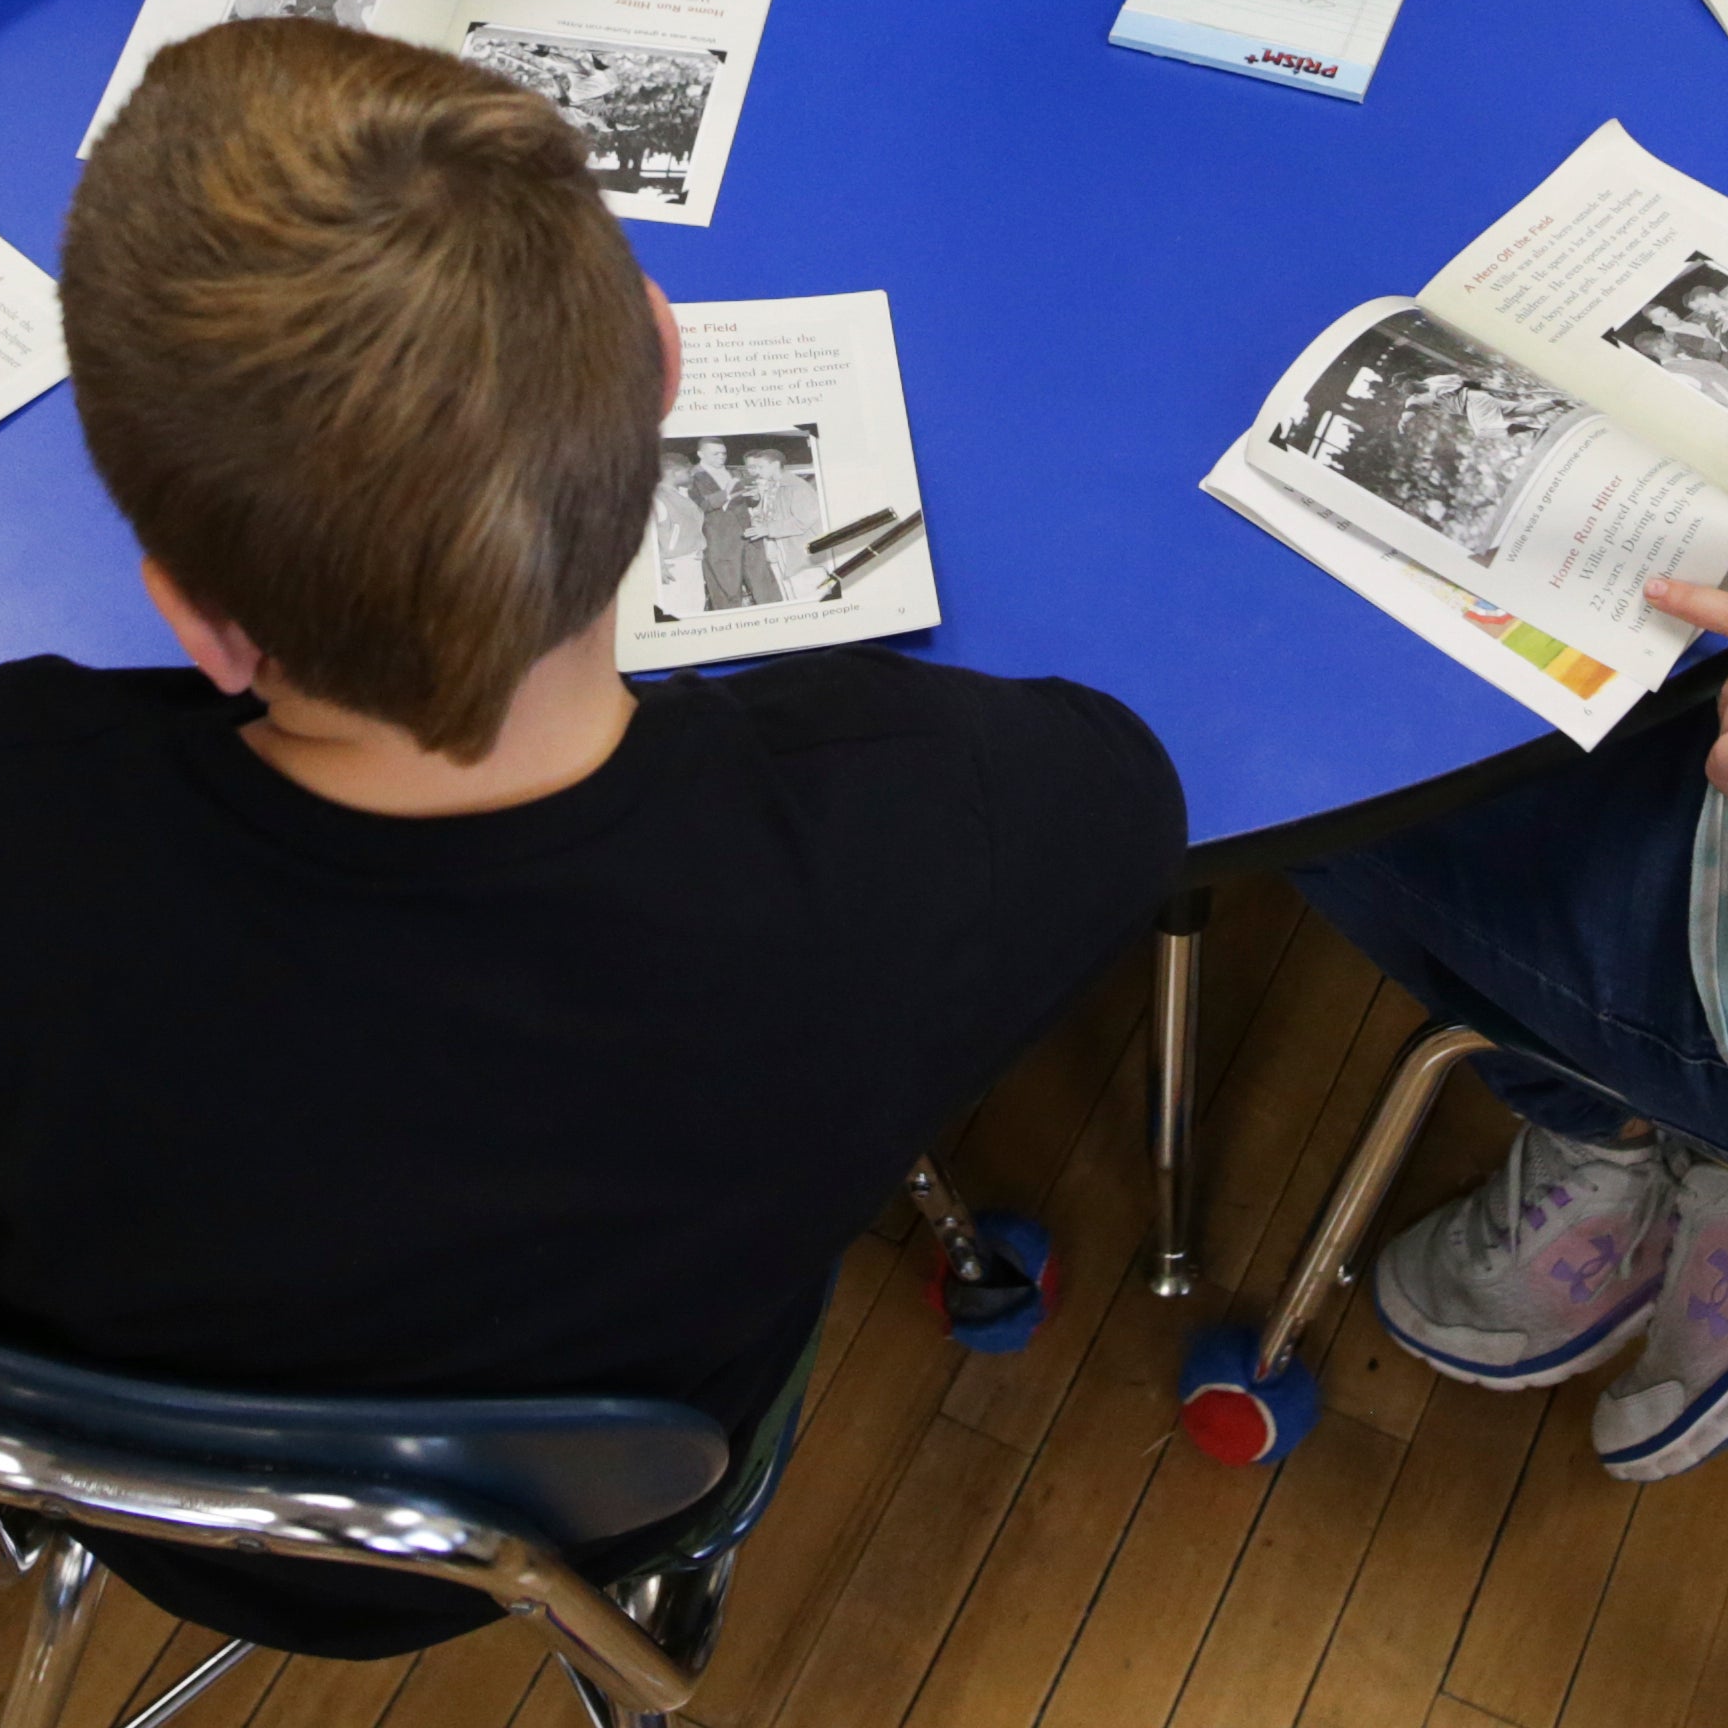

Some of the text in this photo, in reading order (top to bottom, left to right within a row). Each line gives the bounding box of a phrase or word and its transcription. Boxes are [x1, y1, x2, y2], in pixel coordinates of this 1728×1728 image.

[614, 0, 724, 17] Home Run Hitter
[1464, 215, 1554, 294] A Hero Off the Field
[679, 323, 737, 335] he Field
[681, 339, 700, 350] lso
[716, 339, 744, 348] hero
[748, 335, 792, 346] outside
[797, 333, 816, 343] the
[681, 356, 707, 368] pent
[724, 353, 741, 362] lot
[745, 352, 758, 361] of
[762, 352, 789, 360] time
[794, 348, 840, 359] helping
[711, 367, 756, 381] opened
[772, 367, 808, 377] sports
[813, 362, 851, 372] center
[715, 383, 756, 396] Maybe
[788, 379, 801, 389] of
[805, 378, 837, 388] them
[689, 401, 708, 411] the
[713, 402, 739, 410] next
[743, 397, 782, 408] Willie
[1506, 534, 1528, 562] Willie
[1523, 513, 1540, 533] was
[1542, 477, 1562, 504] great
[1549, 475, 1622, 589] Home Run Hitter
[1579, 546, 1607, 579] Willie
[1598, 503, 1630, 546] played
[1589, 594, 1605, 612] 22
[1620, 510, 1655, 555] During
[1650, 487, 1670, 507] that
[1611, 598, 1630, 622] 660
[1623, 563, 1650, 597] home
[1664, 498, 1690, 524] Only
[1657, 547, 1685, 580] home
[633, 630, 666, 640] Willie
[670, 627, 708, 637] always
[710, 622, 732, 632] had
[735, 620, 760, 629] time
[783, 611, 819, 624] young
[1582, 706, 1594, 718] 6
